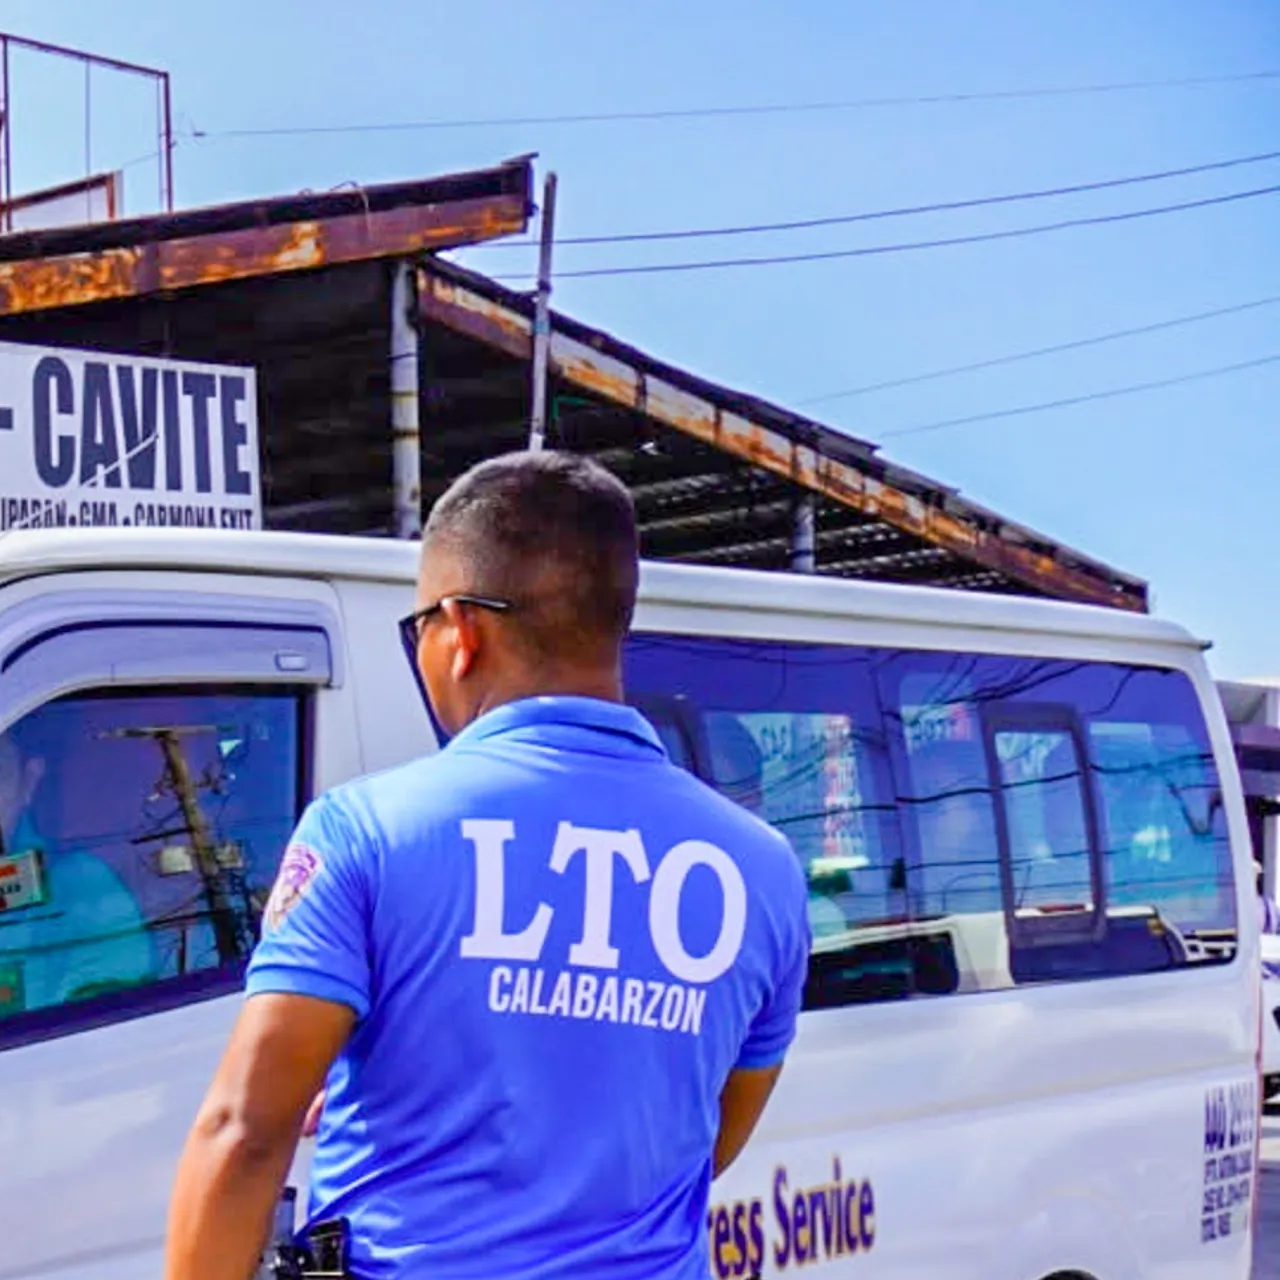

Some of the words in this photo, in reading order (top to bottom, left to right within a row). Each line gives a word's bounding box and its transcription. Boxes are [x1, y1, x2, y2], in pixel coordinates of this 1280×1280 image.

[32, 355, 252, 496] CAVITE
[459, 818, 748, 984] LTO
[488, 965, 707, 1036] CALABARZON
[773, 1154, 876, 1270] Service
